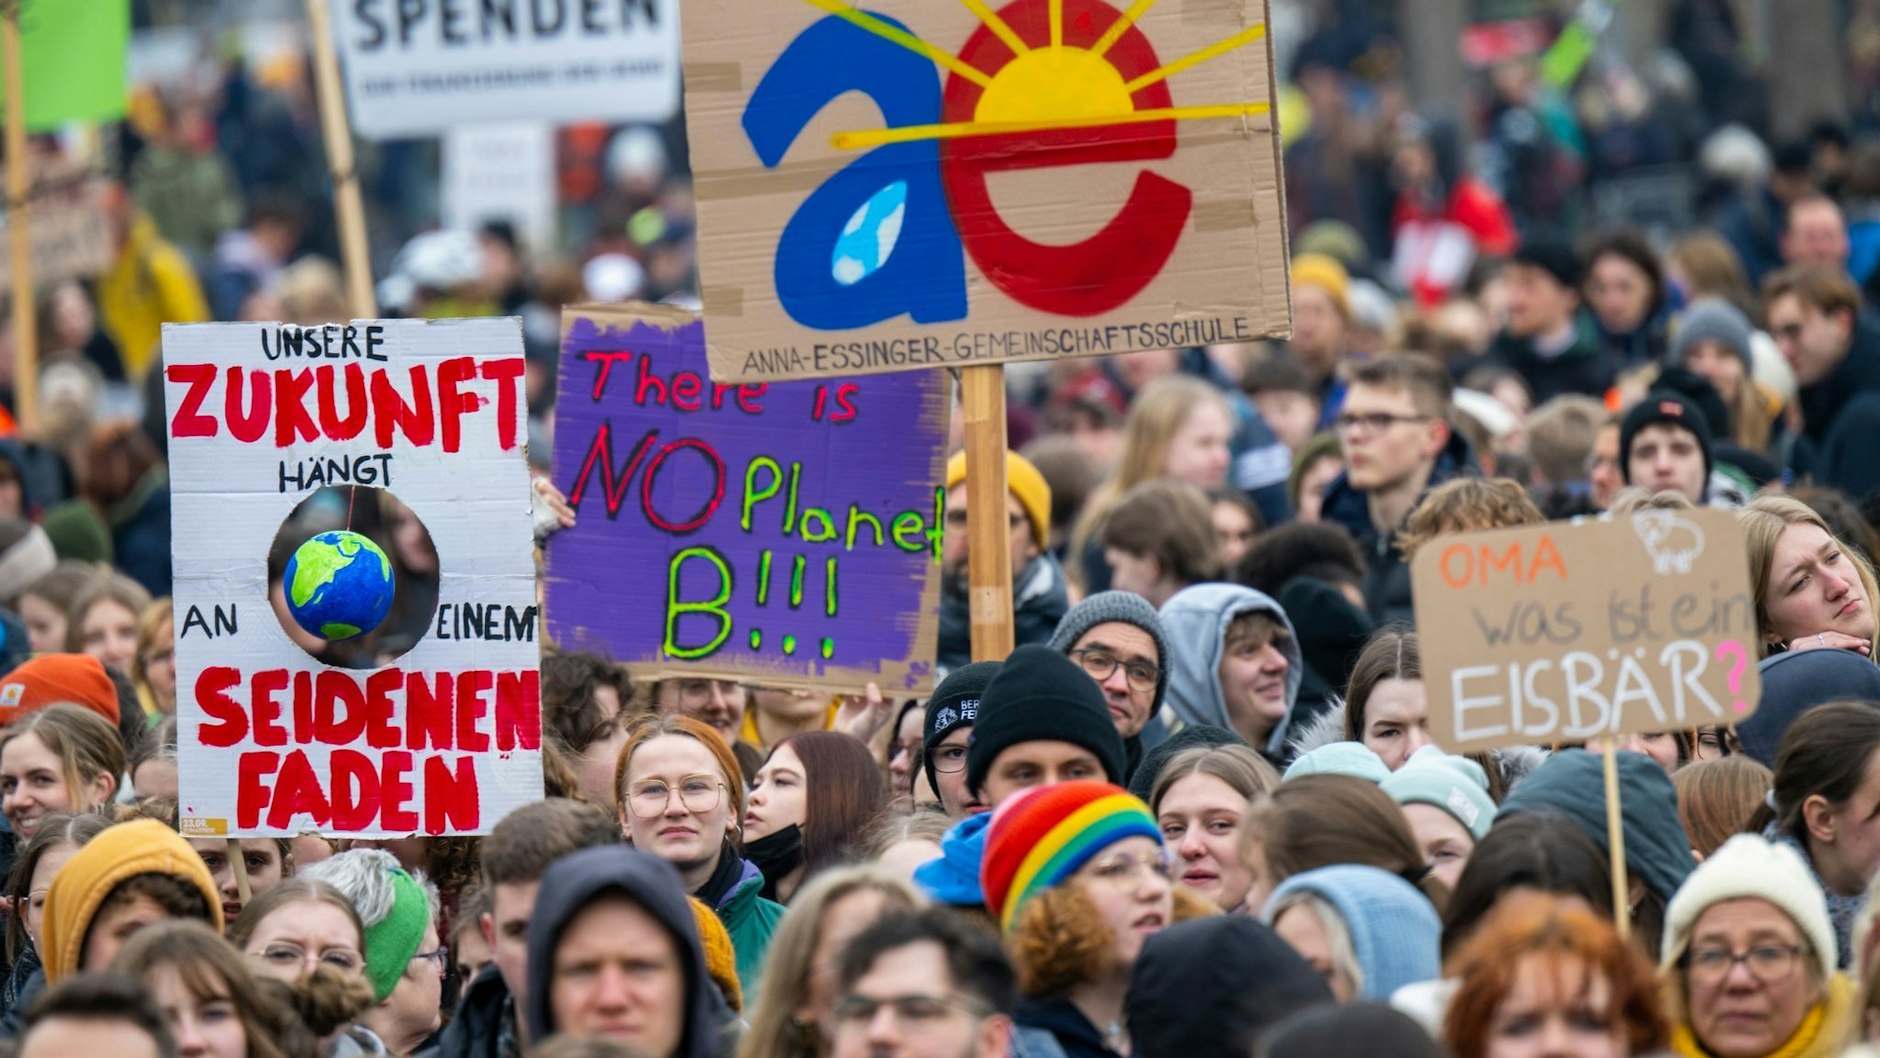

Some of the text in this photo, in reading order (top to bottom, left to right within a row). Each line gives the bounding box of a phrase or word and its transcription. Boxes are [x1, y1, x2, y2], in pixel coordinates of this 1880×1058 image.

[354, 0, 660, 51] SPENDEN
[261, 326, 389, 361] UNSERE
[742, 317, 1251, 375] ANNA-ESSINGER-GEMEINSCHAFTSSCHULE
[165, 356, 526, 453] ZUKUNFT
[578, 349, 860, 421] There is
[278, 453, 394, 493] HÄNGT
[567, 420, 946, 566] NO Planet
[1439, 533, 1569, 589] OMA
[180, 602, 538, 642] AN EINEM
[662, 545, 838, 660] B!!!
[1471, 580, 1750, 647] was ist ein
[195, 666, 540, 752] SEIDENEN
[1452, 638, 1749, 742] EISBÄR?
[236, 748, 480, 835] FADEN
